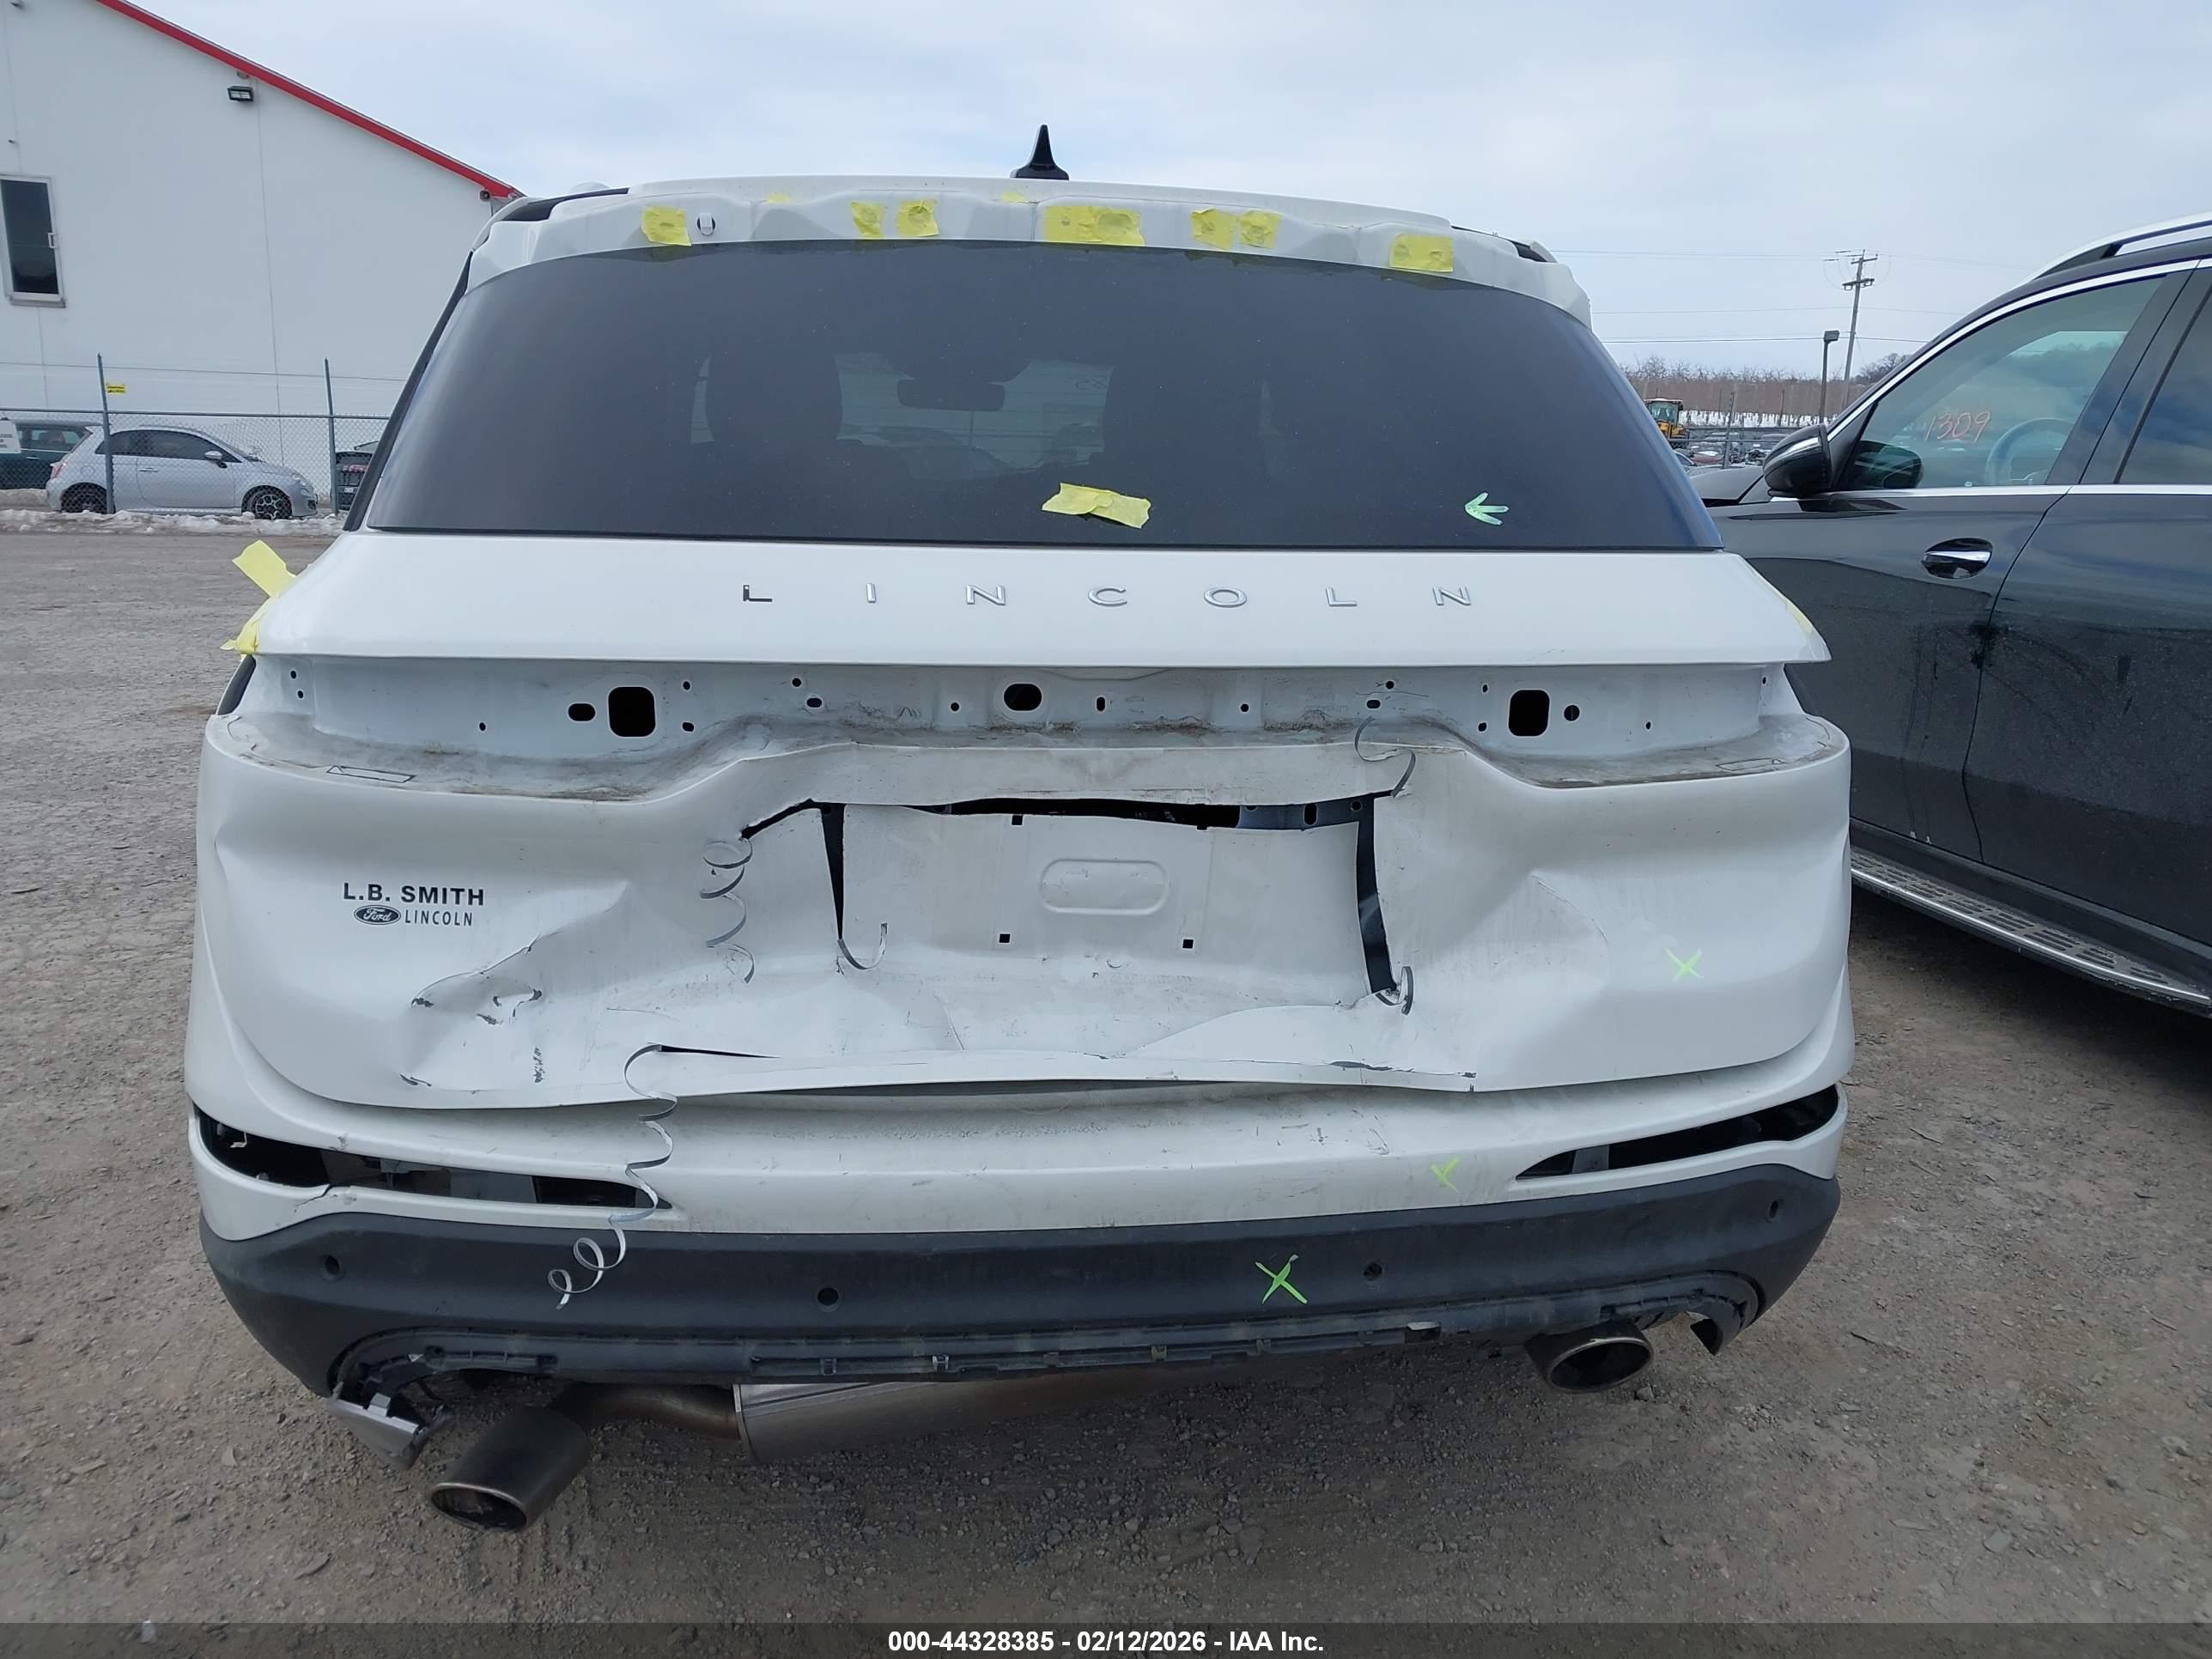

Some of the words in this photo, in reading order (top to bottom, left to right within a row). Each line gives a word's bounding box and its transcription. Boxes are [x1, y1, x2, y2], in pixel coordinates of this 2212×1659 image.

[1924, 411, 1990, 443] 1309
[742, 583, 1471, 608] LINCOLN
[343, 883, 391, 902] L.B.
[401, 885, 483, 906] SMITH
[361, 907, 394, 922] Ford
[404, 909, 472, 927] LINCOLN
